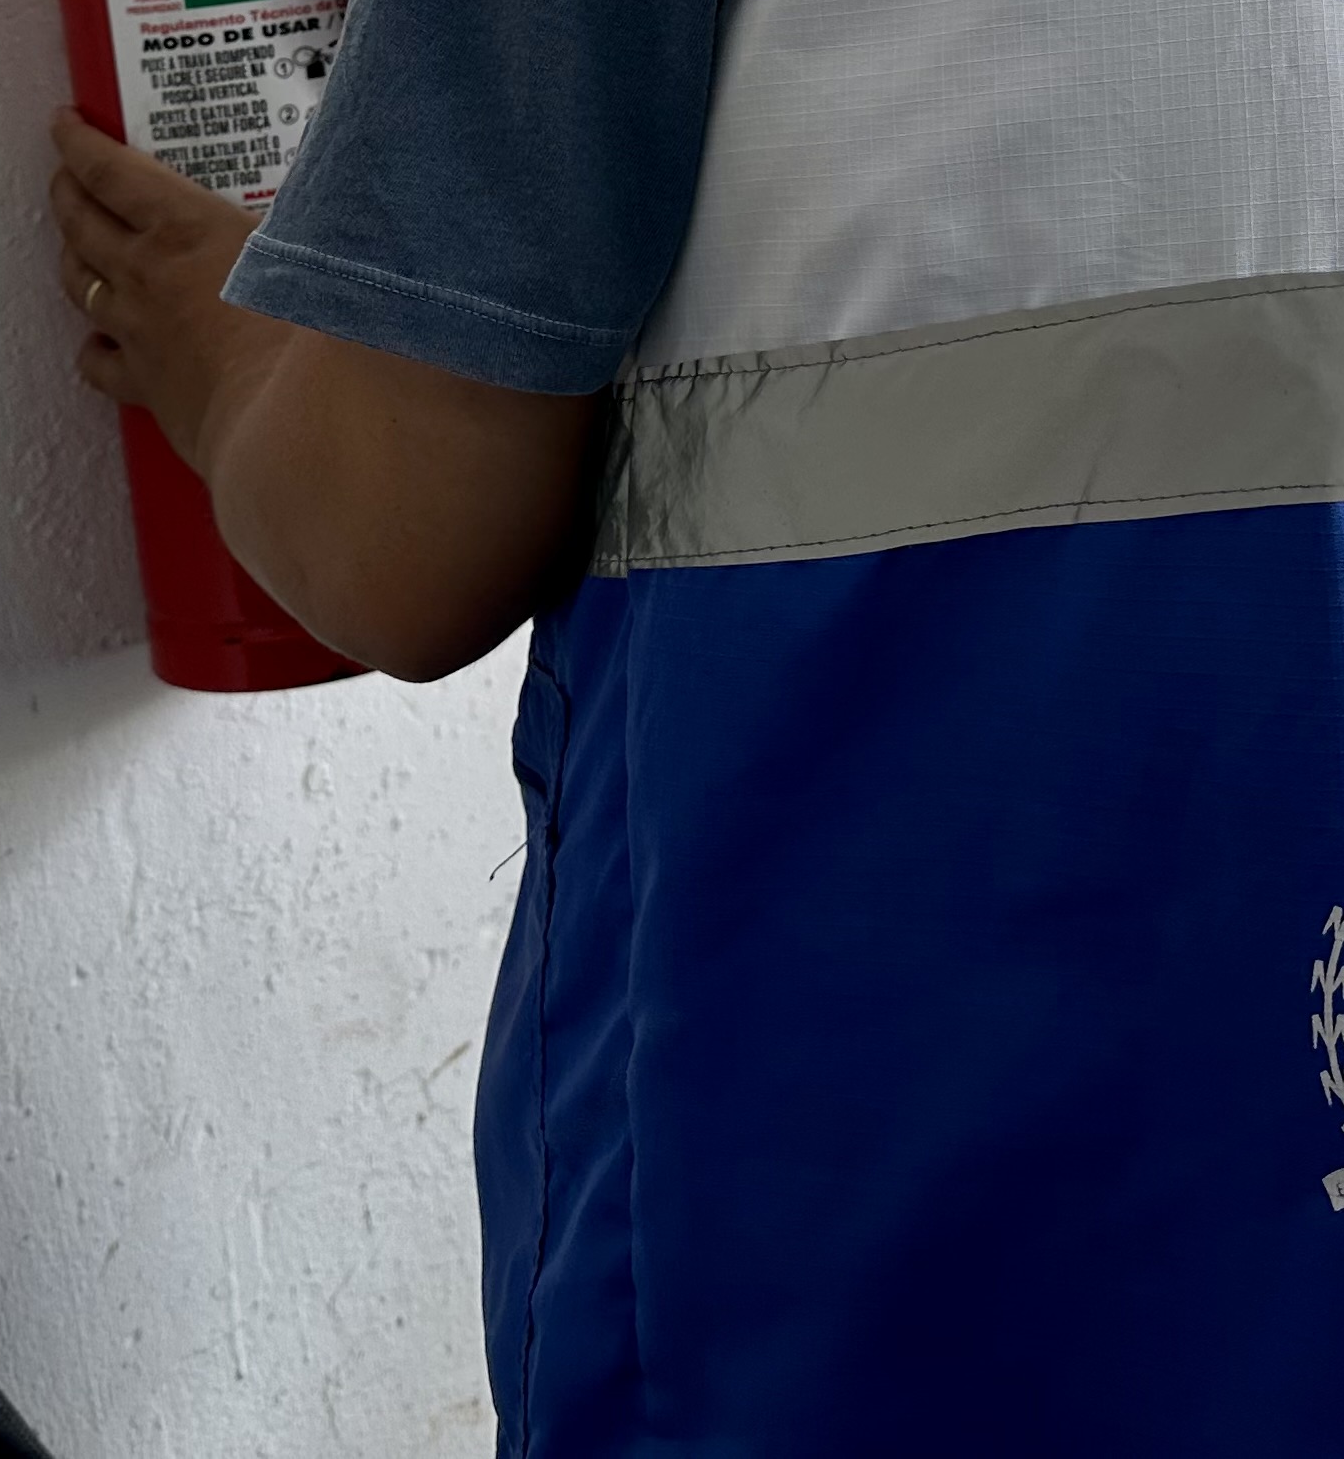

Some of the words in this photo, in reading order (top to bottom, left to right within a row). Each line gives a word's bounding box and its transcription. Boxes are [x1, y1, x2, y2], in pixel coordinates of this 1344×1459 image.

[140, 13, 245, 35] Regulamento
[250, 5, 314, 22] Técnico
[143, 33, 215, 52] MODO
[224, 27, 253, 43] DE
[262, 17, 320, 37] USAR
[251, 61, 266, 77] NA
[204, 119, 230, 136] COM
